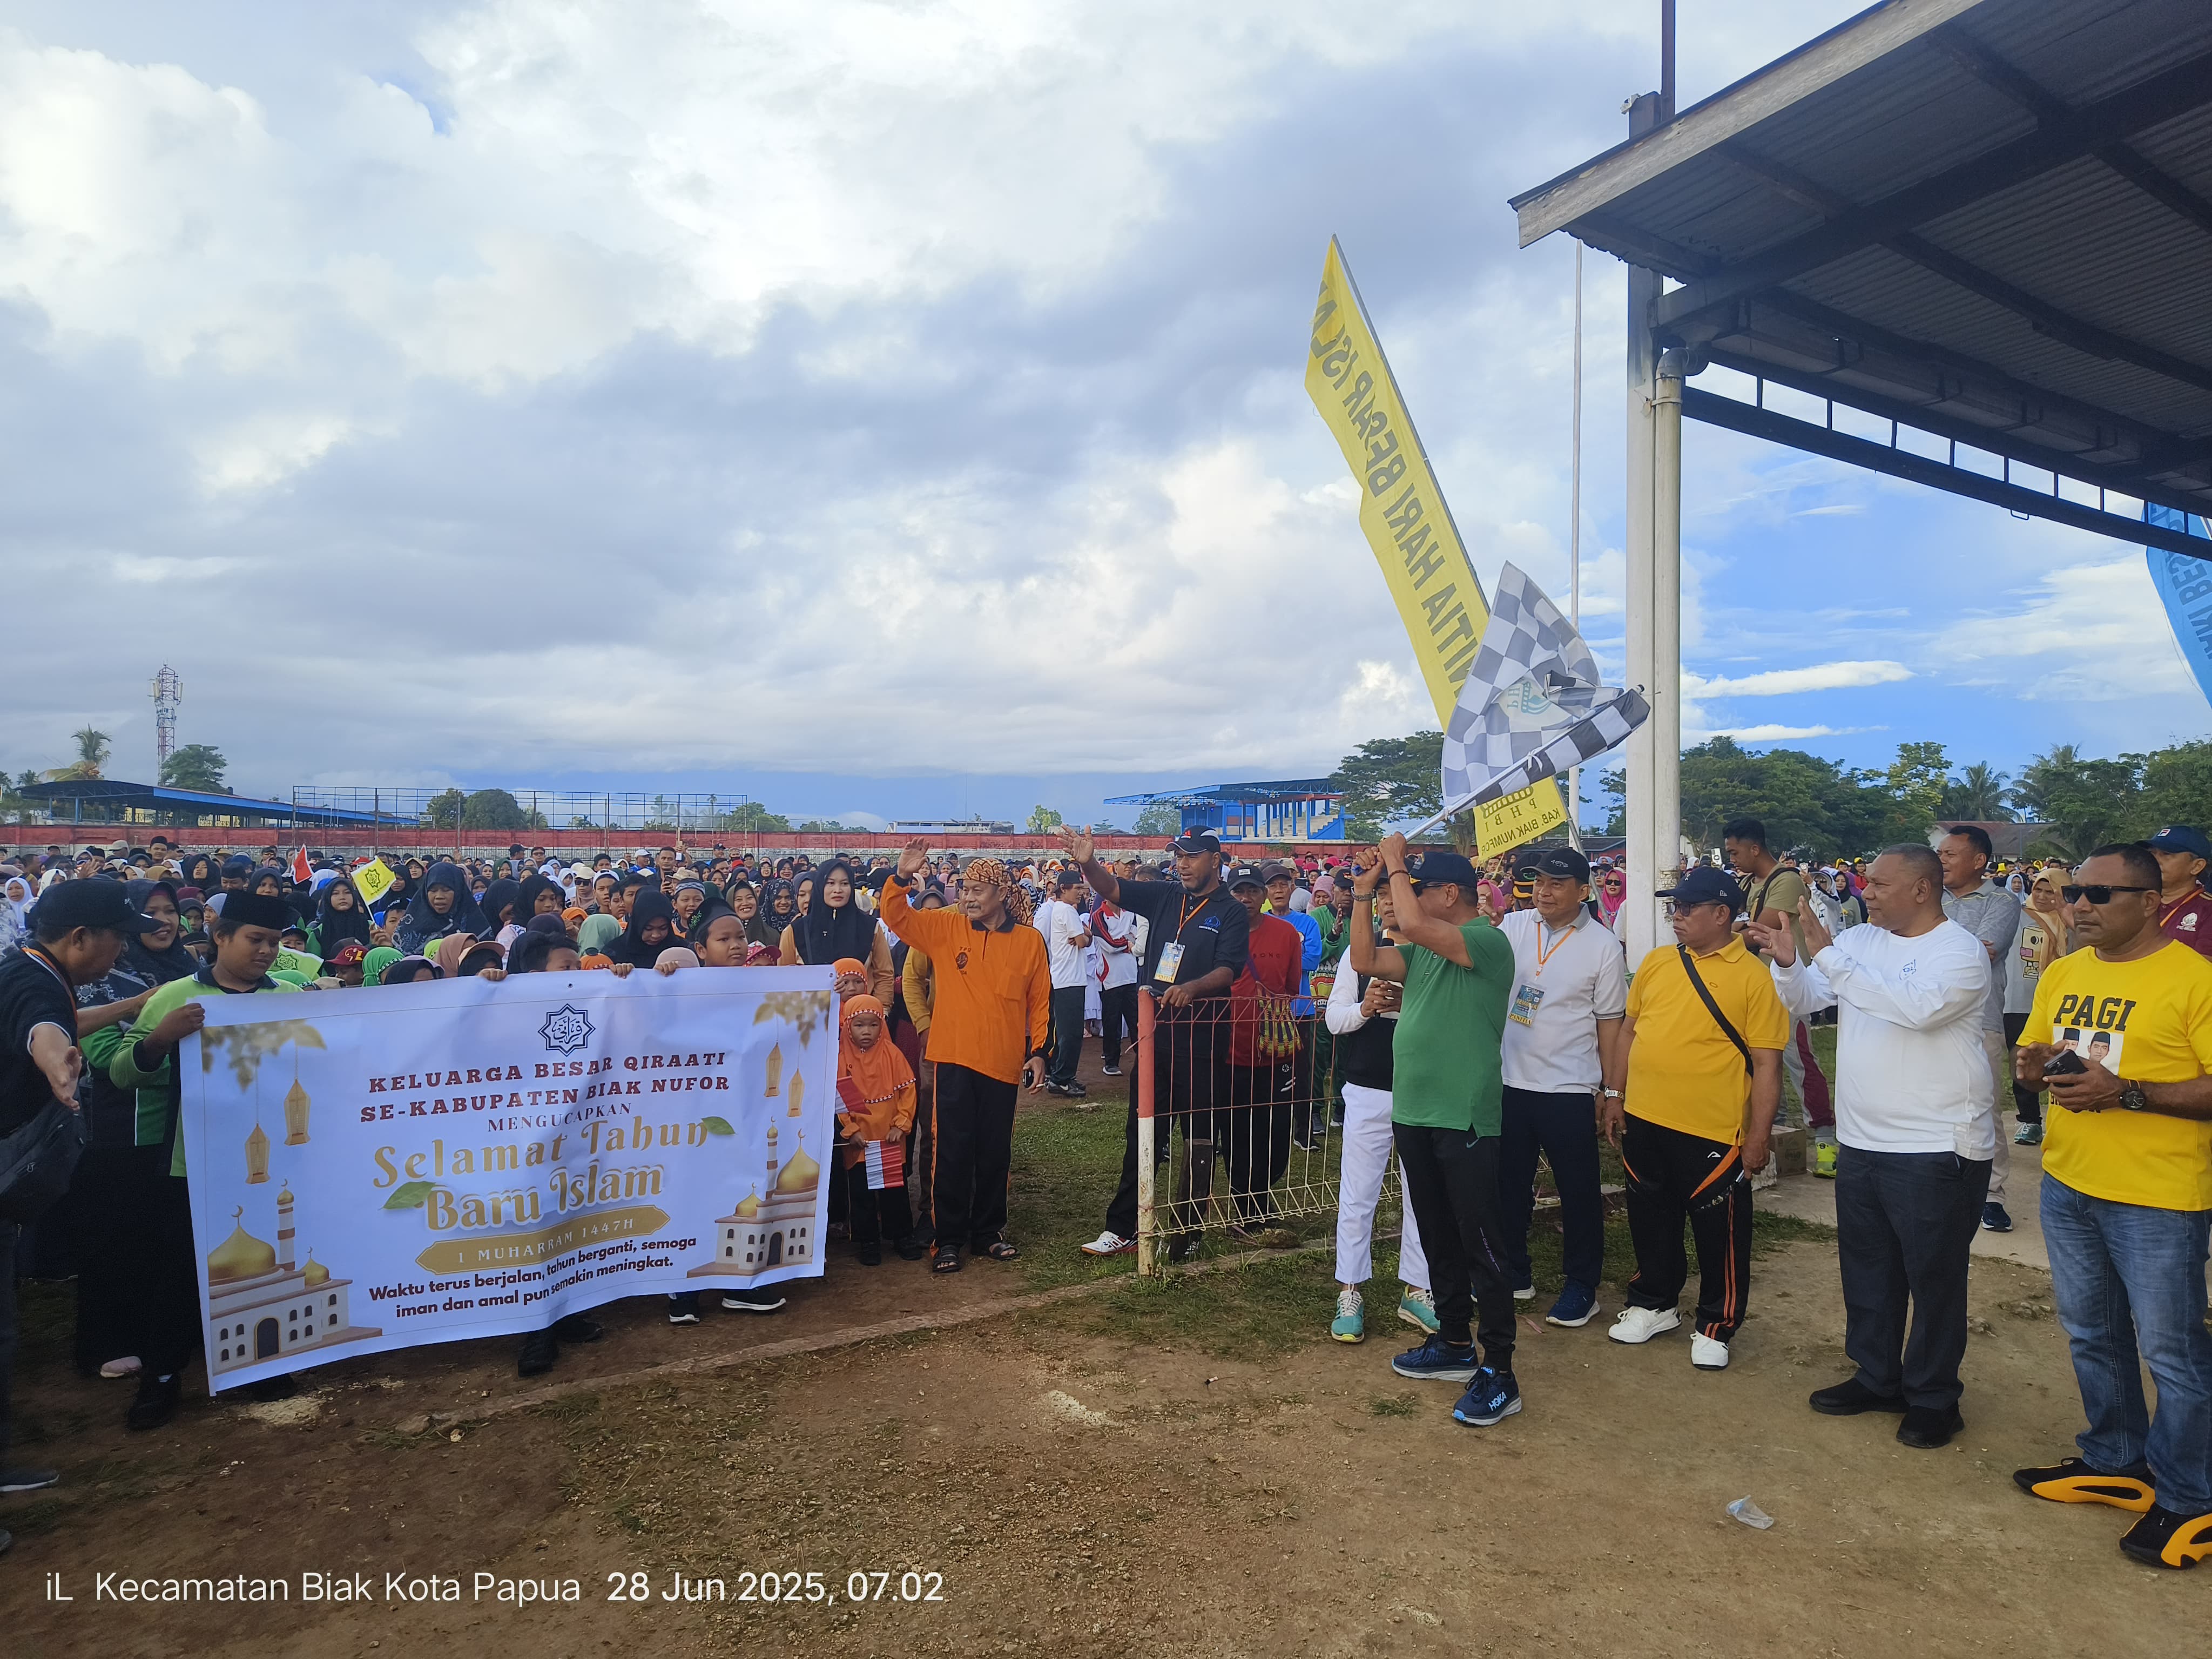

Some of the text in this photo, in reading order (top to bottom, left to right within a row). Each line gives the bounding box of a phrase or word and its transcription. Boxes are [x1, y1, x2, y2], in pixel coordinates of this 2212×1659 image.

[2054, 994, 2137, 1031] PAGI
[369, 1053, 725, 1093] KELUARGA BESAR QIRAATI
[361, 1076, 729, 1122] SE-KABUPATEN BIAK NUFOR
[488, 1103, 631, 1132] MENGUCAPKAN
[373, 1116, 709, 1188] Selamat Tahun
[417, 1159, 664, 1230] Baru Islam
[459, 1218, 633, 1263] 1 MUHARRAM 1447H
[369, 1238, 697, 1301] Waktu terus berjalan, tahun berganti, semoga
[396, 1256, 673, 1318] iman dan amal pun semakin meningkat.
[1488, 1391, 1507, 1412] HOKA
